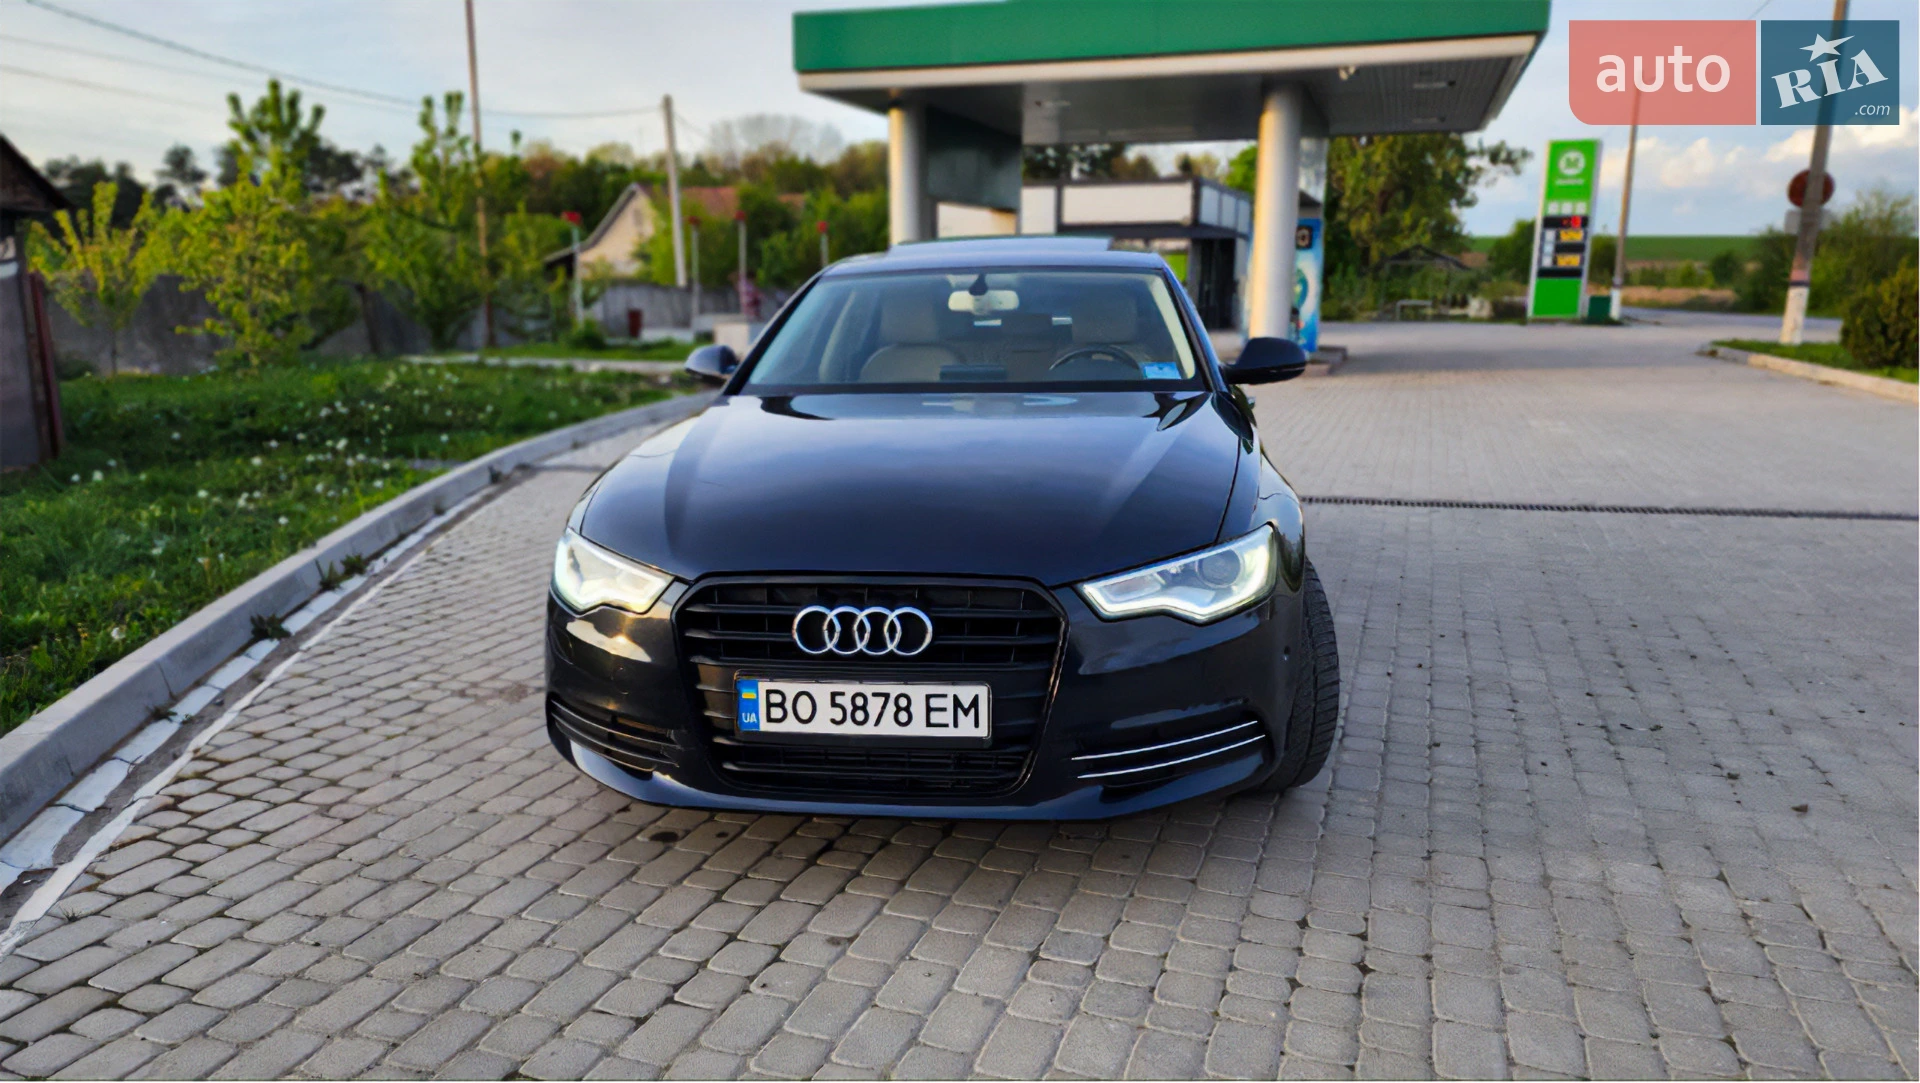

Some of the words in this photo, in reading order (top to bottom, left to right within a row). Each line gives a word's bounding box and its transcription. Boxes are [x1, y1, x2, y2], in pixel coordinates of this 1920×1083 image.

[742, 712, 757, 723] UA
[765, 689, 817, 724] BO
[829, 691, 913, 728] 5878
[925, 693, 980, 729] EM
